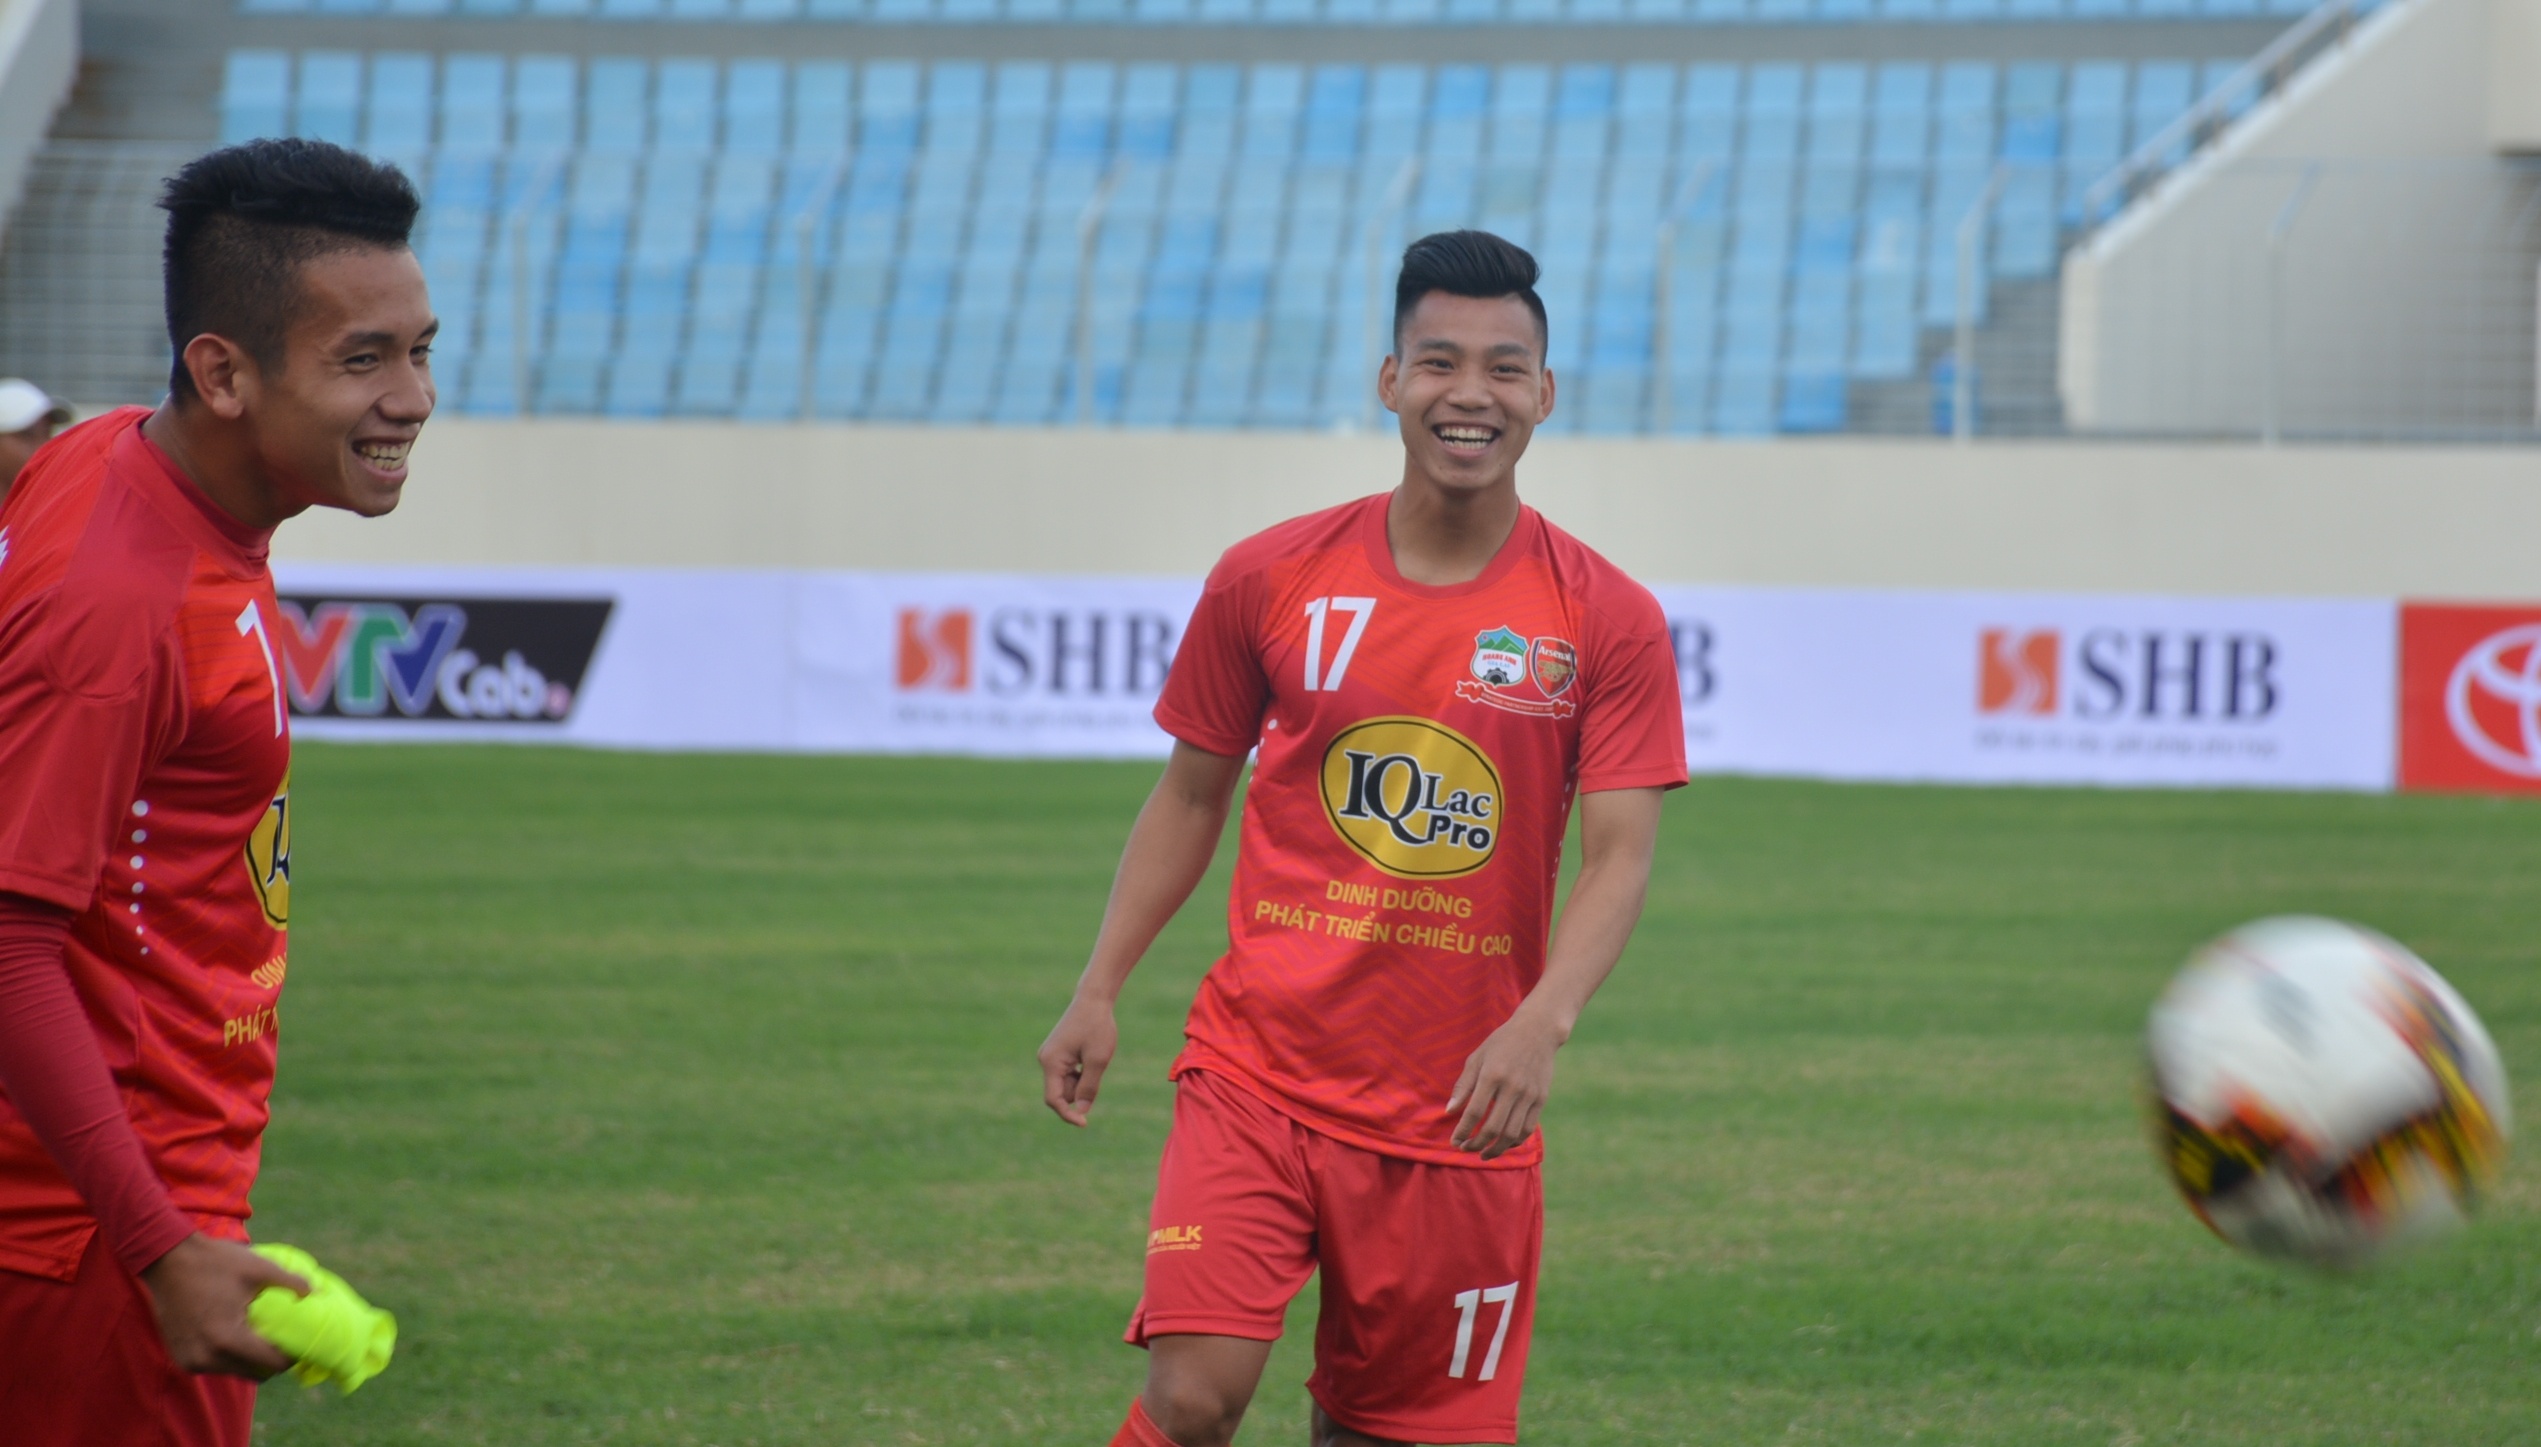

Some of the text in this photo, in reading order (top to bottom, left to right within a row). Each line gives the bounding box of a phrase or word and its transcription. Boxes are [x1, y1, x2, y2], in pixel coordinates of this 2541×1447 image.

[278, 602, 467, 715] VTV
[985, 607, 1176, 694] SHB
[1304, 596, 1377, 691] 17
[1539, 646, 1571, 662] Arsenal
[2075, 629, 2278, 722] SHB
[1427, 814, 1491, 850] Pro
[1255, 900, 1512, 956] PHÁT TRIỂN CHIỀU CAO
[1326, 880, 1472, 918] DINH DƯỠNG
[224, 1003, 271, 1047] PHÁT
[1448, 1281, 1519, 1381] 17
